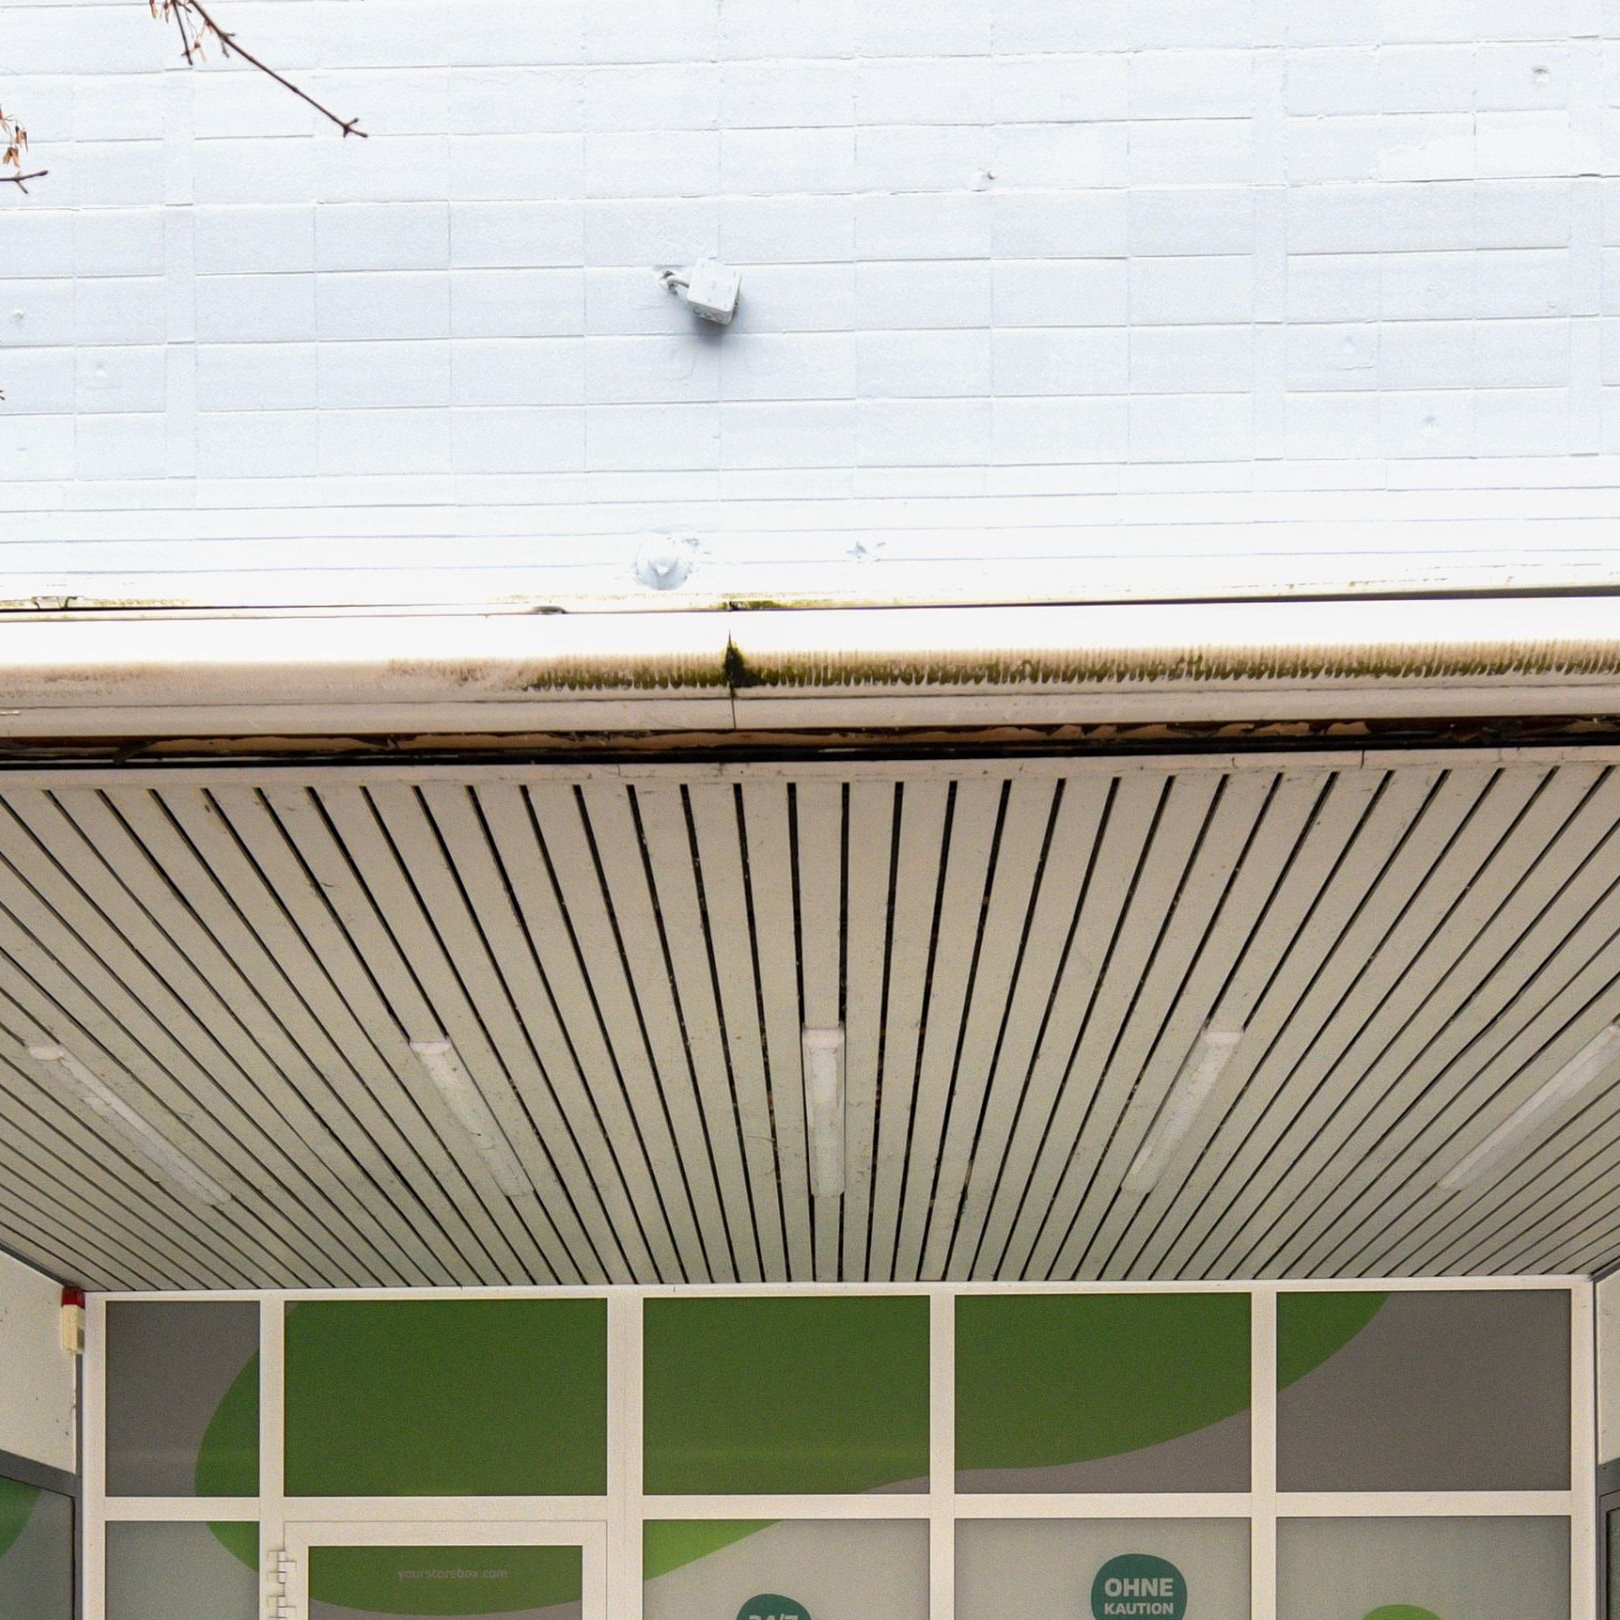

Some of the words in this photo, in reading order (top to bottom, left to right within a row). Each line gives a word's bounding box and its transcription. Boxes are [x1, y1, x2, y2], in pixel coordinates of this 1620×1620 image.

[398, 1567, 509, 1580] yourstorebox.com
[1104, 1576, 1174, 1599] OHNE
[1104, 1602, 1175, 1616] KAUTION
